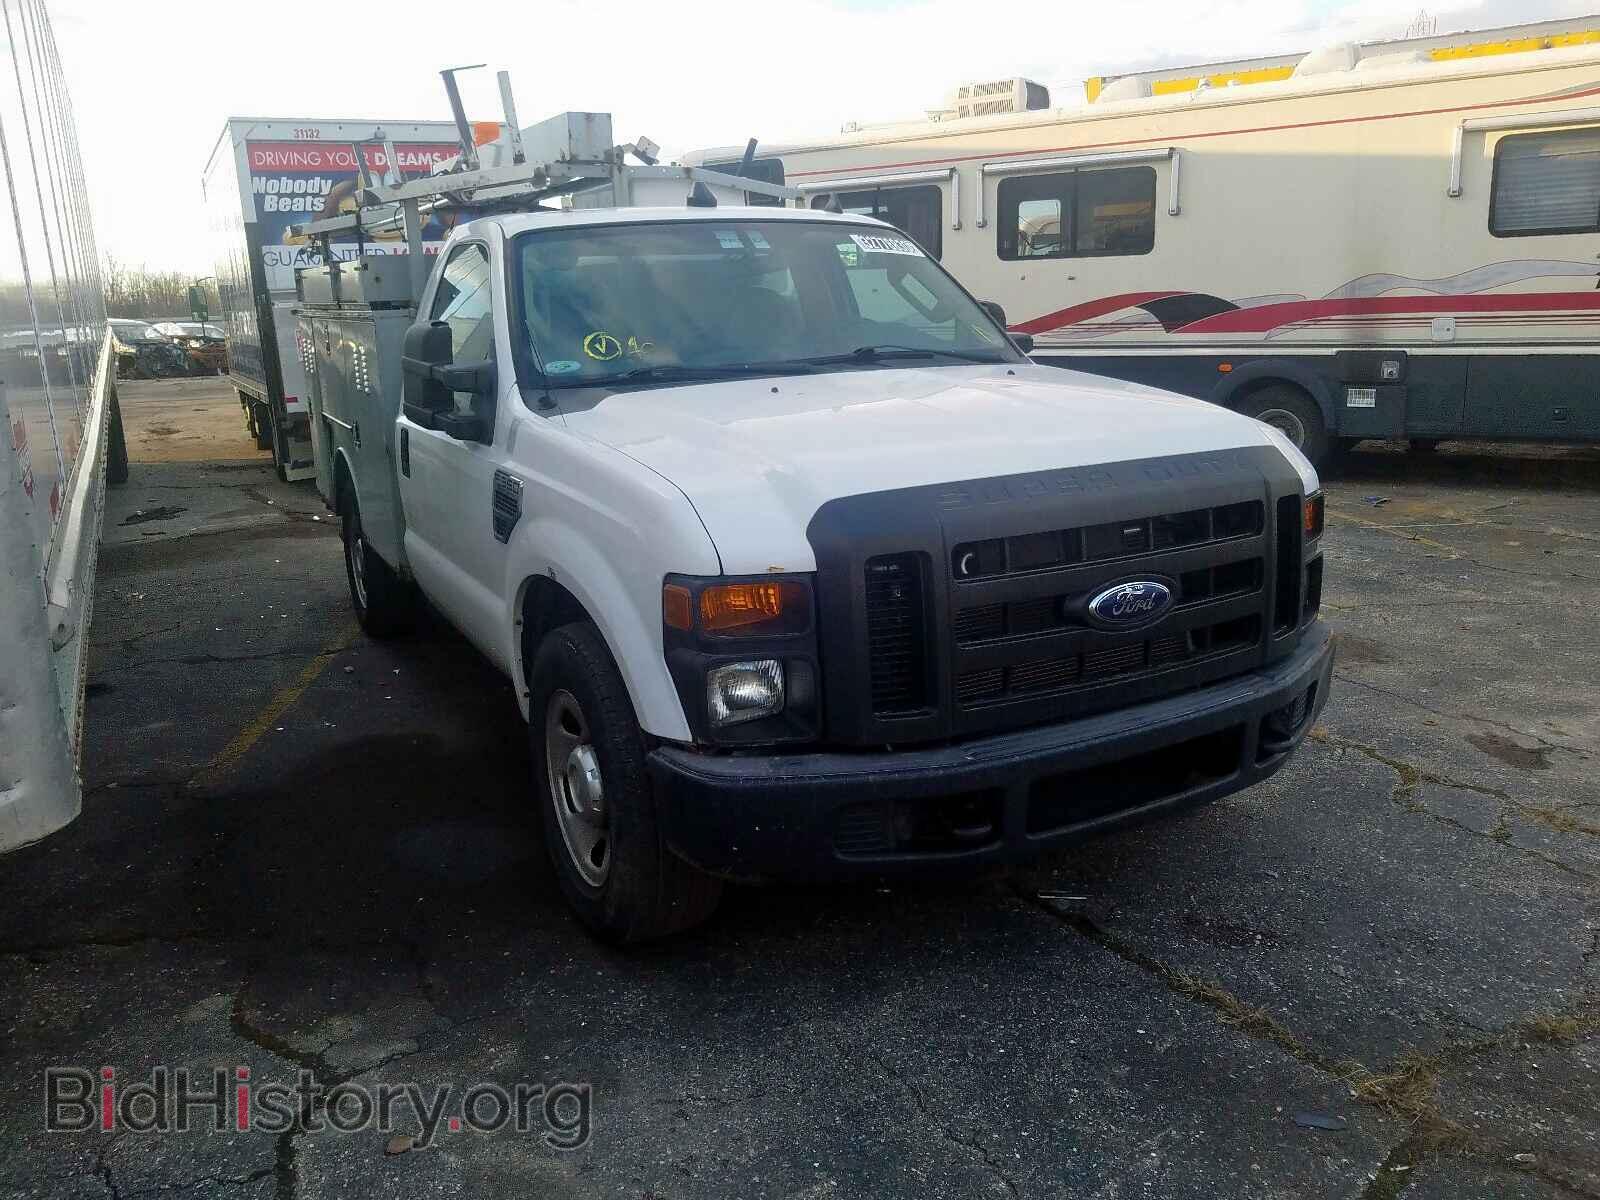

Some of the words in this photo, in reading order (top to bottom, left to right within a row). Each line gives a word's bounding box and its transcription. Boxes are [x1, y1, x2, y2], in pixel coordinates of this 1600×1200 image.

[254, 151, 321, 166] DRIVING
[253, 176, 332, 195] Nobody
[264, 194, 325, 212] Beats
